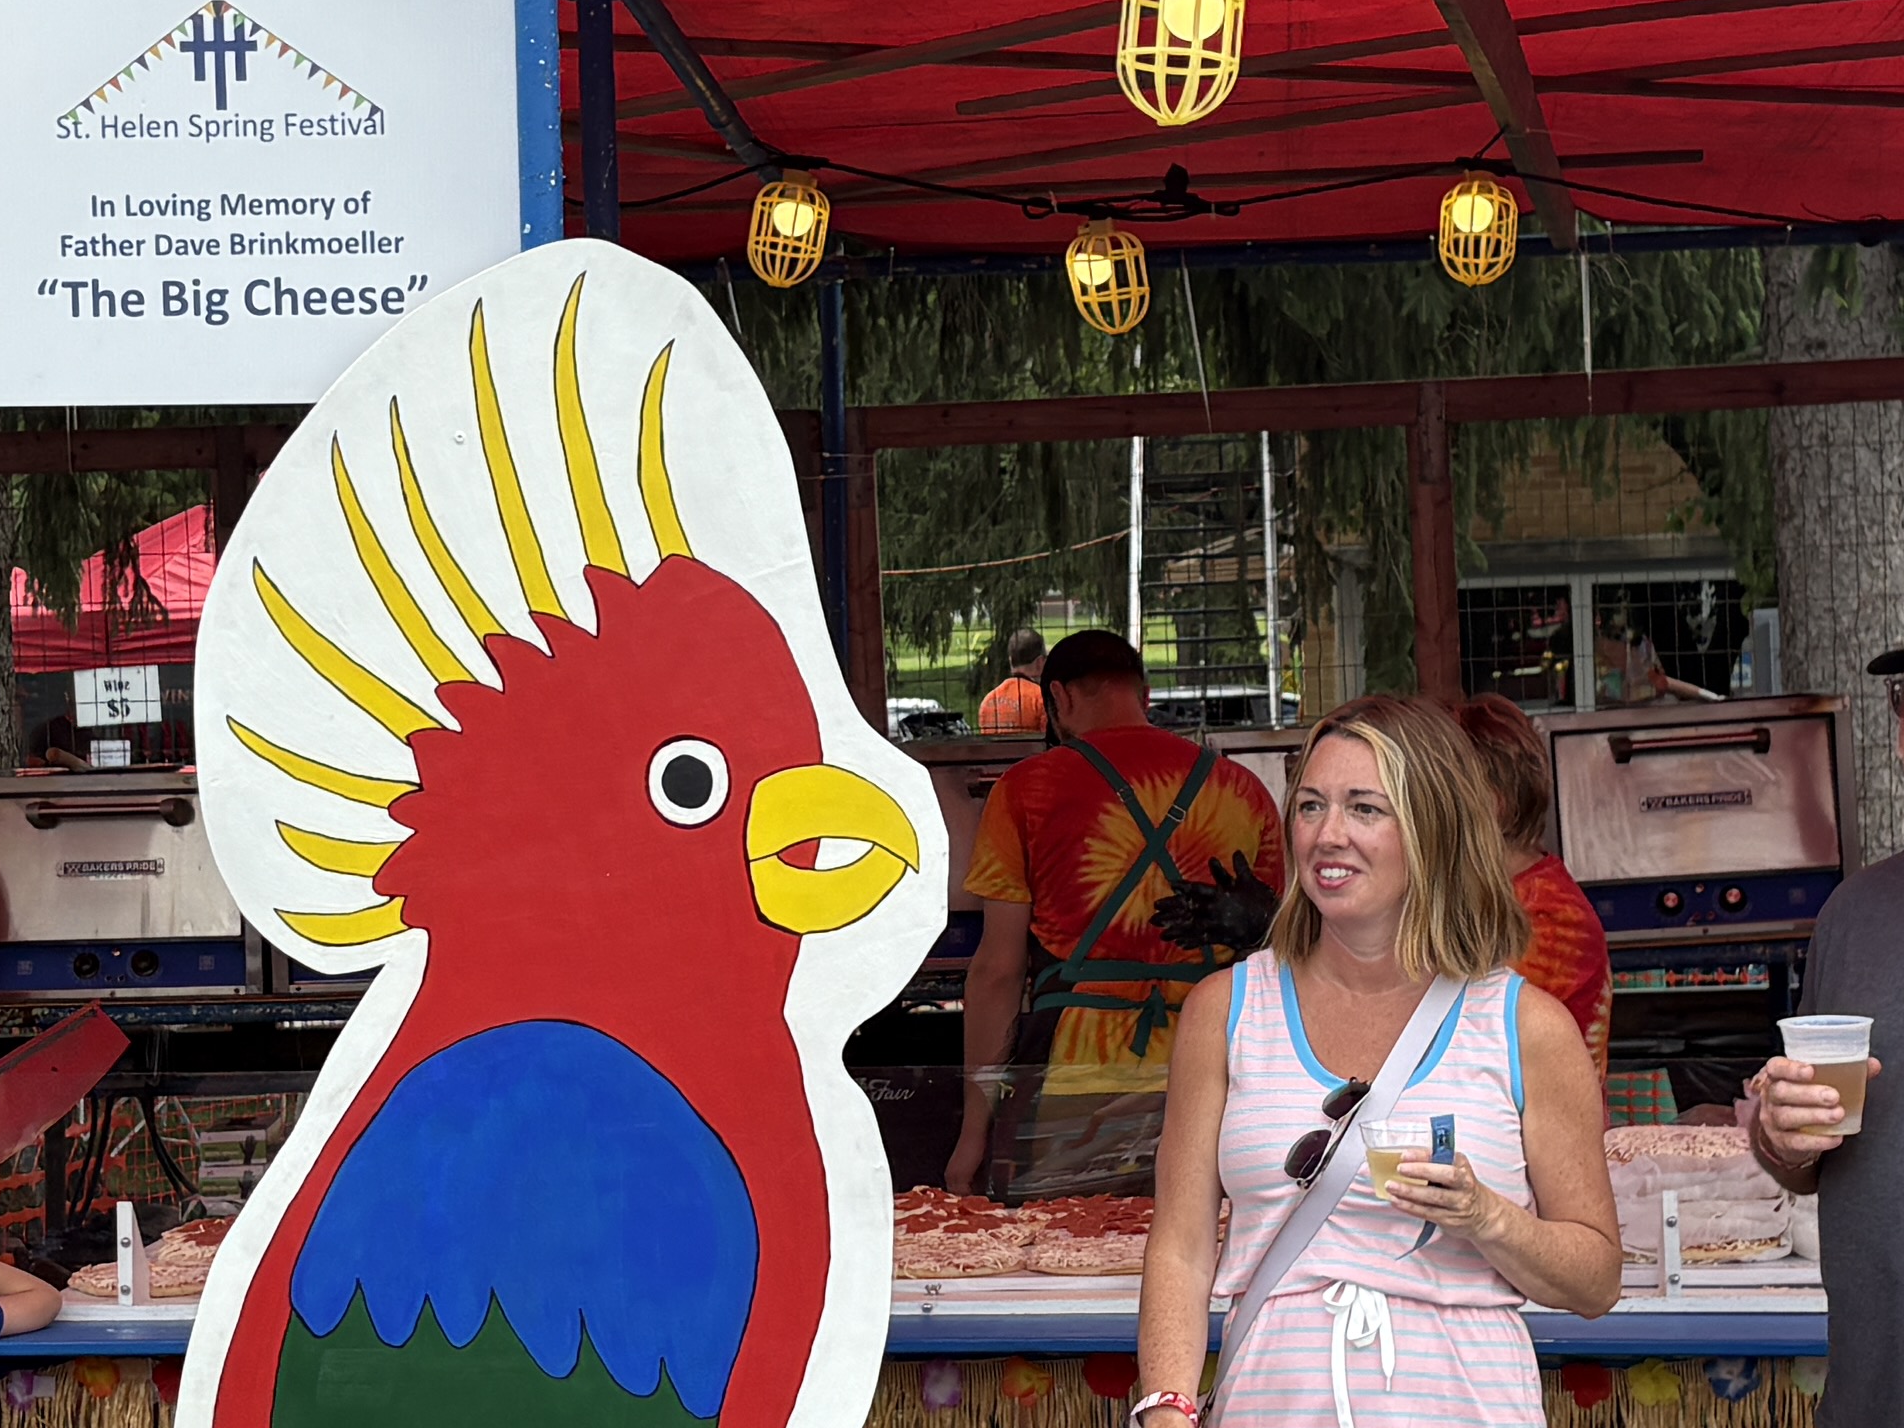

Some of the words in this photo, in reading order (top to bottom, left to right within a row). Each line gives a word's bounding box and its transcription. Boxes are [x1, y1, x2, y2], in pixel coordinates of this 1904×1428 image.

[55, 114, 91, 140] St.
[100, 113, 179, 139] Helen
[187, 111, 275, 144] Spring
[283, 109, 386, 138] Festival
[90, 193, 116, 218] In
[124, 192, 212, 223] Loving
[219, 191, 336, 222] Memory
[341, 190, 372, 216] of
[59, 232, 147, 258] Father
[153, 232, 222, 257] Dave
[229, 230, 405, 257] Brinkmoeller
[36, 276, 147, 319] “The
[161, 275, 229, 325] Big
[242, 273, 430, 318] Cheese”
[1665, 794, 1711, 808] BAKERS
[81, 861, 125, 874] BAKERS
[125, 860, 157, 872] PRIDE
